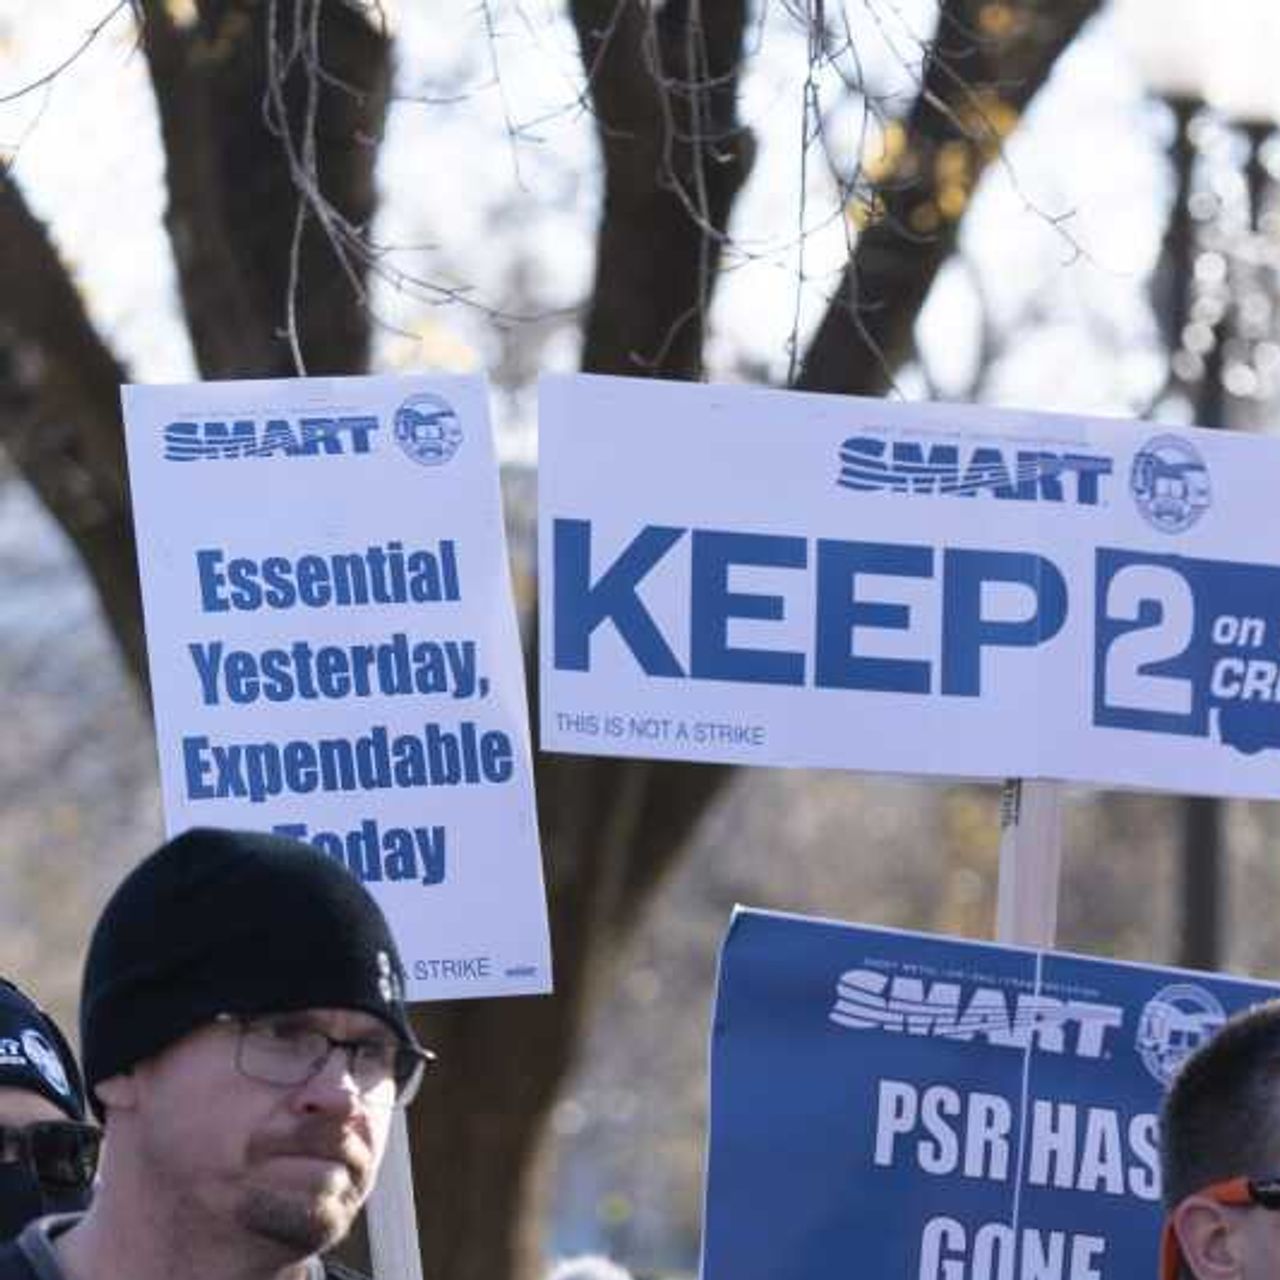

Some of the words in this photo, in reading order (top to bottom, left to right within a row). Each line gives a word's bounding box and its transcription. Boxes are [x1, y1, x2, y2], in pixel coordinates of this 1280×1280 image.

[163, 416, 378, 462] SMART
[836, 437, 1113, 505] SMART
[196, 541, 461, 613] Essential
[553, 518, 1068, 697] KEEP
[1104, 564, 1194, 716] 2
[1212, 615, 1264, 648] on
[188, 633, 489, 705] Yesterday,
[183, 723, 514, 802] Expendable
[557, 713, 598, 735] THIS
[605, 717, 624, 737] IS
[629, 718, 671, 739] NOT
[676, 722, 689, 741] A
[693, 722, 766, 745] STRIKE
[414, 957, 491, 980] STRIKE
[829, 968, 1123, 1058] SMART
[873, 1080, 1010, 1181] PSR
[1029, 1100, 1162, 1201] HAS
